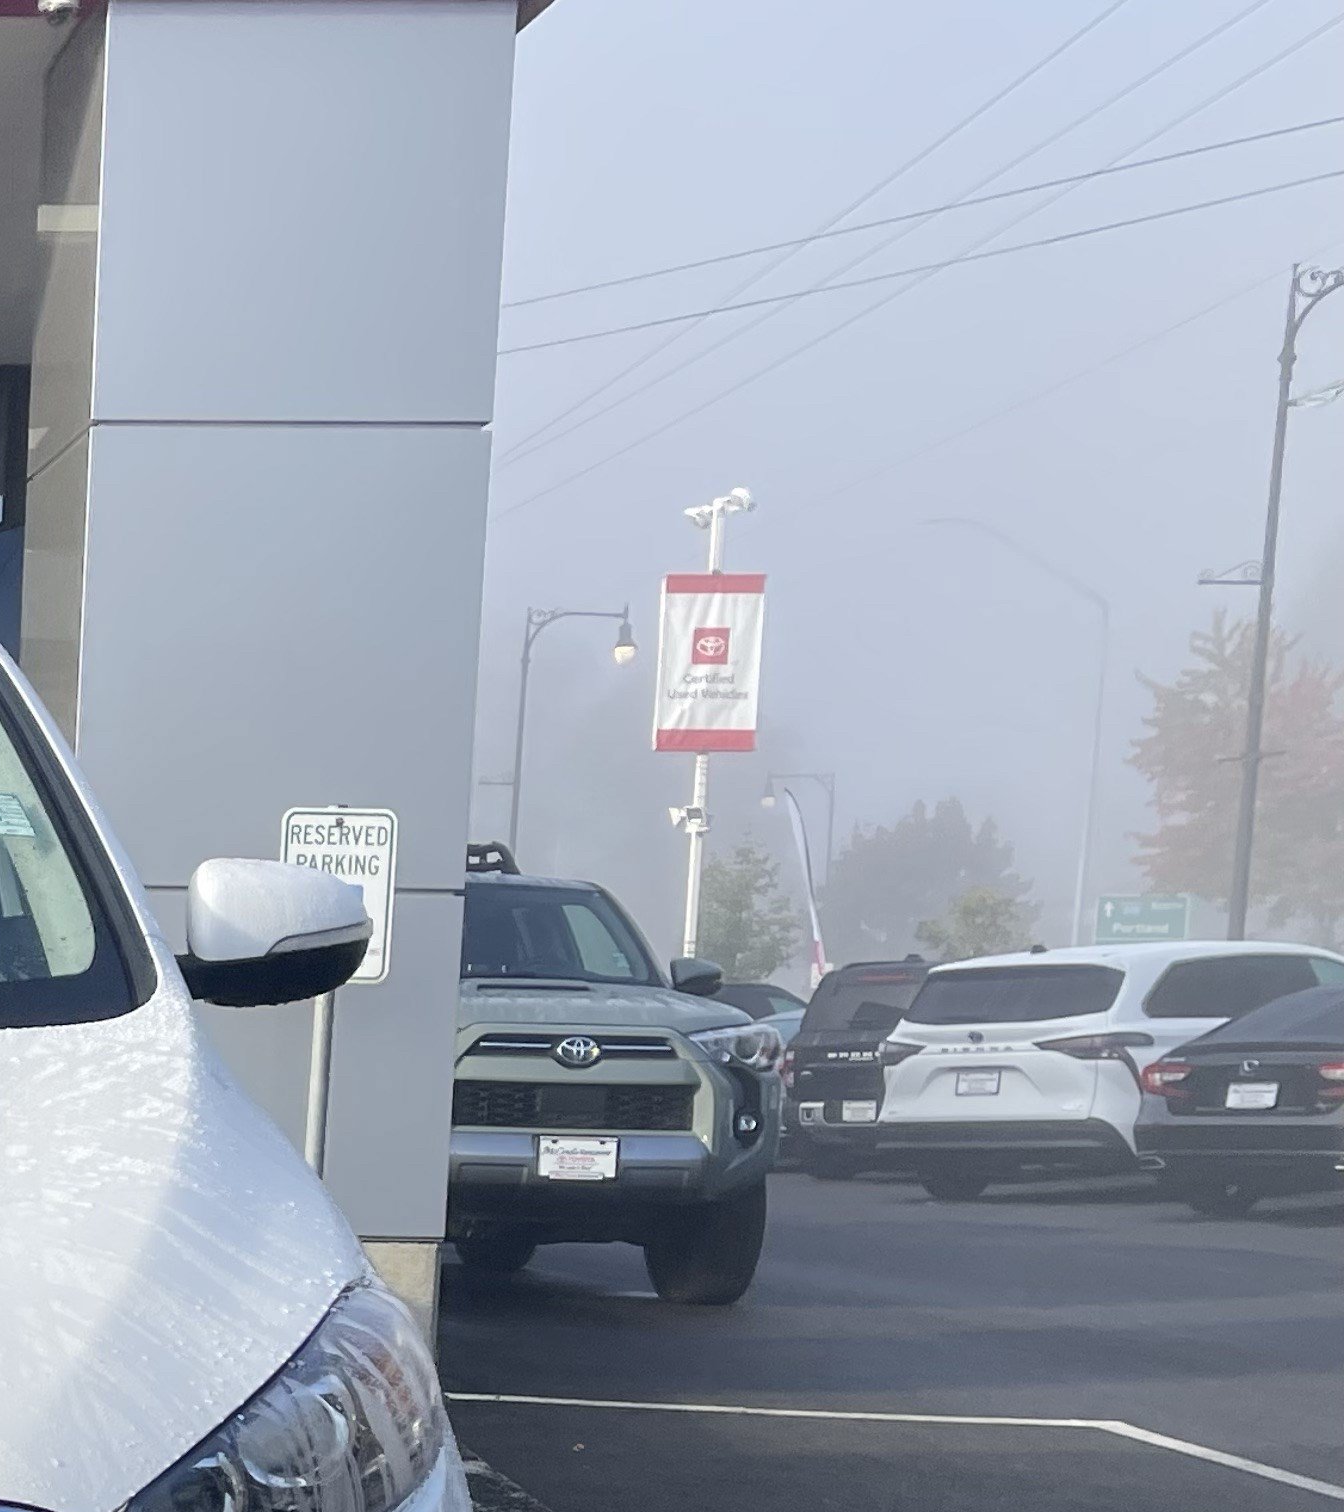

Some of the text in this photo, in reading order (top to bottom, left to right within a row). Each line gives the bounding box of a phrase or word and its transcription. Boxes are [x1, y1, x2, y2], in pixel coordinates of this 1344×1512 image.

[682, 673, 735, 684] Certified
[667, 688, 749, 699] Used Vehicles
[290, 824, 388, 846] RESERVED
[296, 854, 380, 875] PARKING
